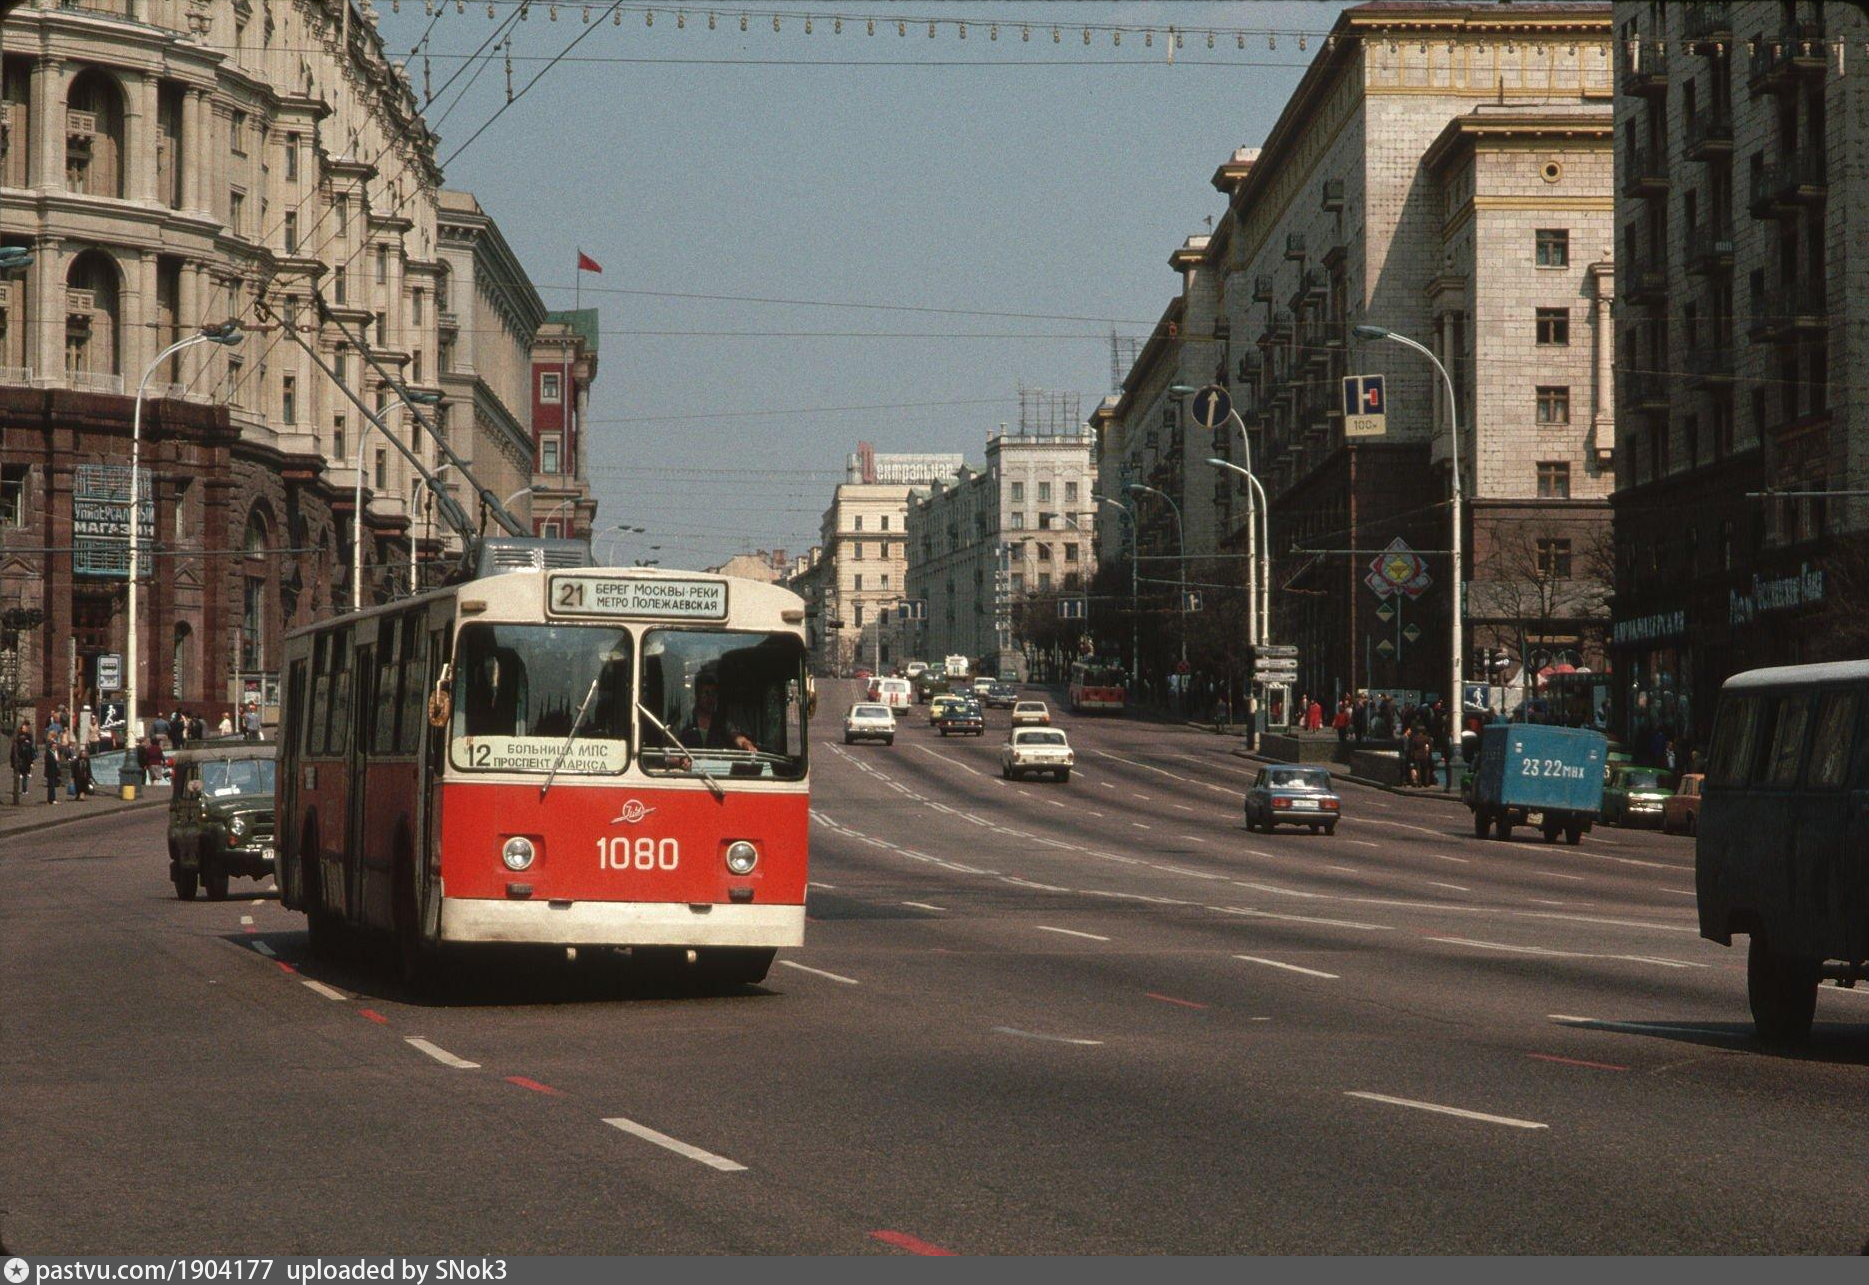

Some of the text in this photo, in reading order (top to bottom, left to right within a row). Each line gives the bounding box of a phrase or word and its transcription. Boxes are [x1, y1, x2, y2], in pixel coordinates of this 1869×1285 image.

[560, 583, 584, 607] 21
[595, 583, 630, 595] БЕРЕГ
[596, 596, 718, 611] МЕТРО ПОЛЕЖАЕВСКАЯ
[467, 743, 608, 768] 12 БОЛЬНИЦА МПС
[493, 756, 552, 768] ПРОСПЕКТ
[1522, 758, 1540, 776] 23
[596, 837, 678, 870] 1080
